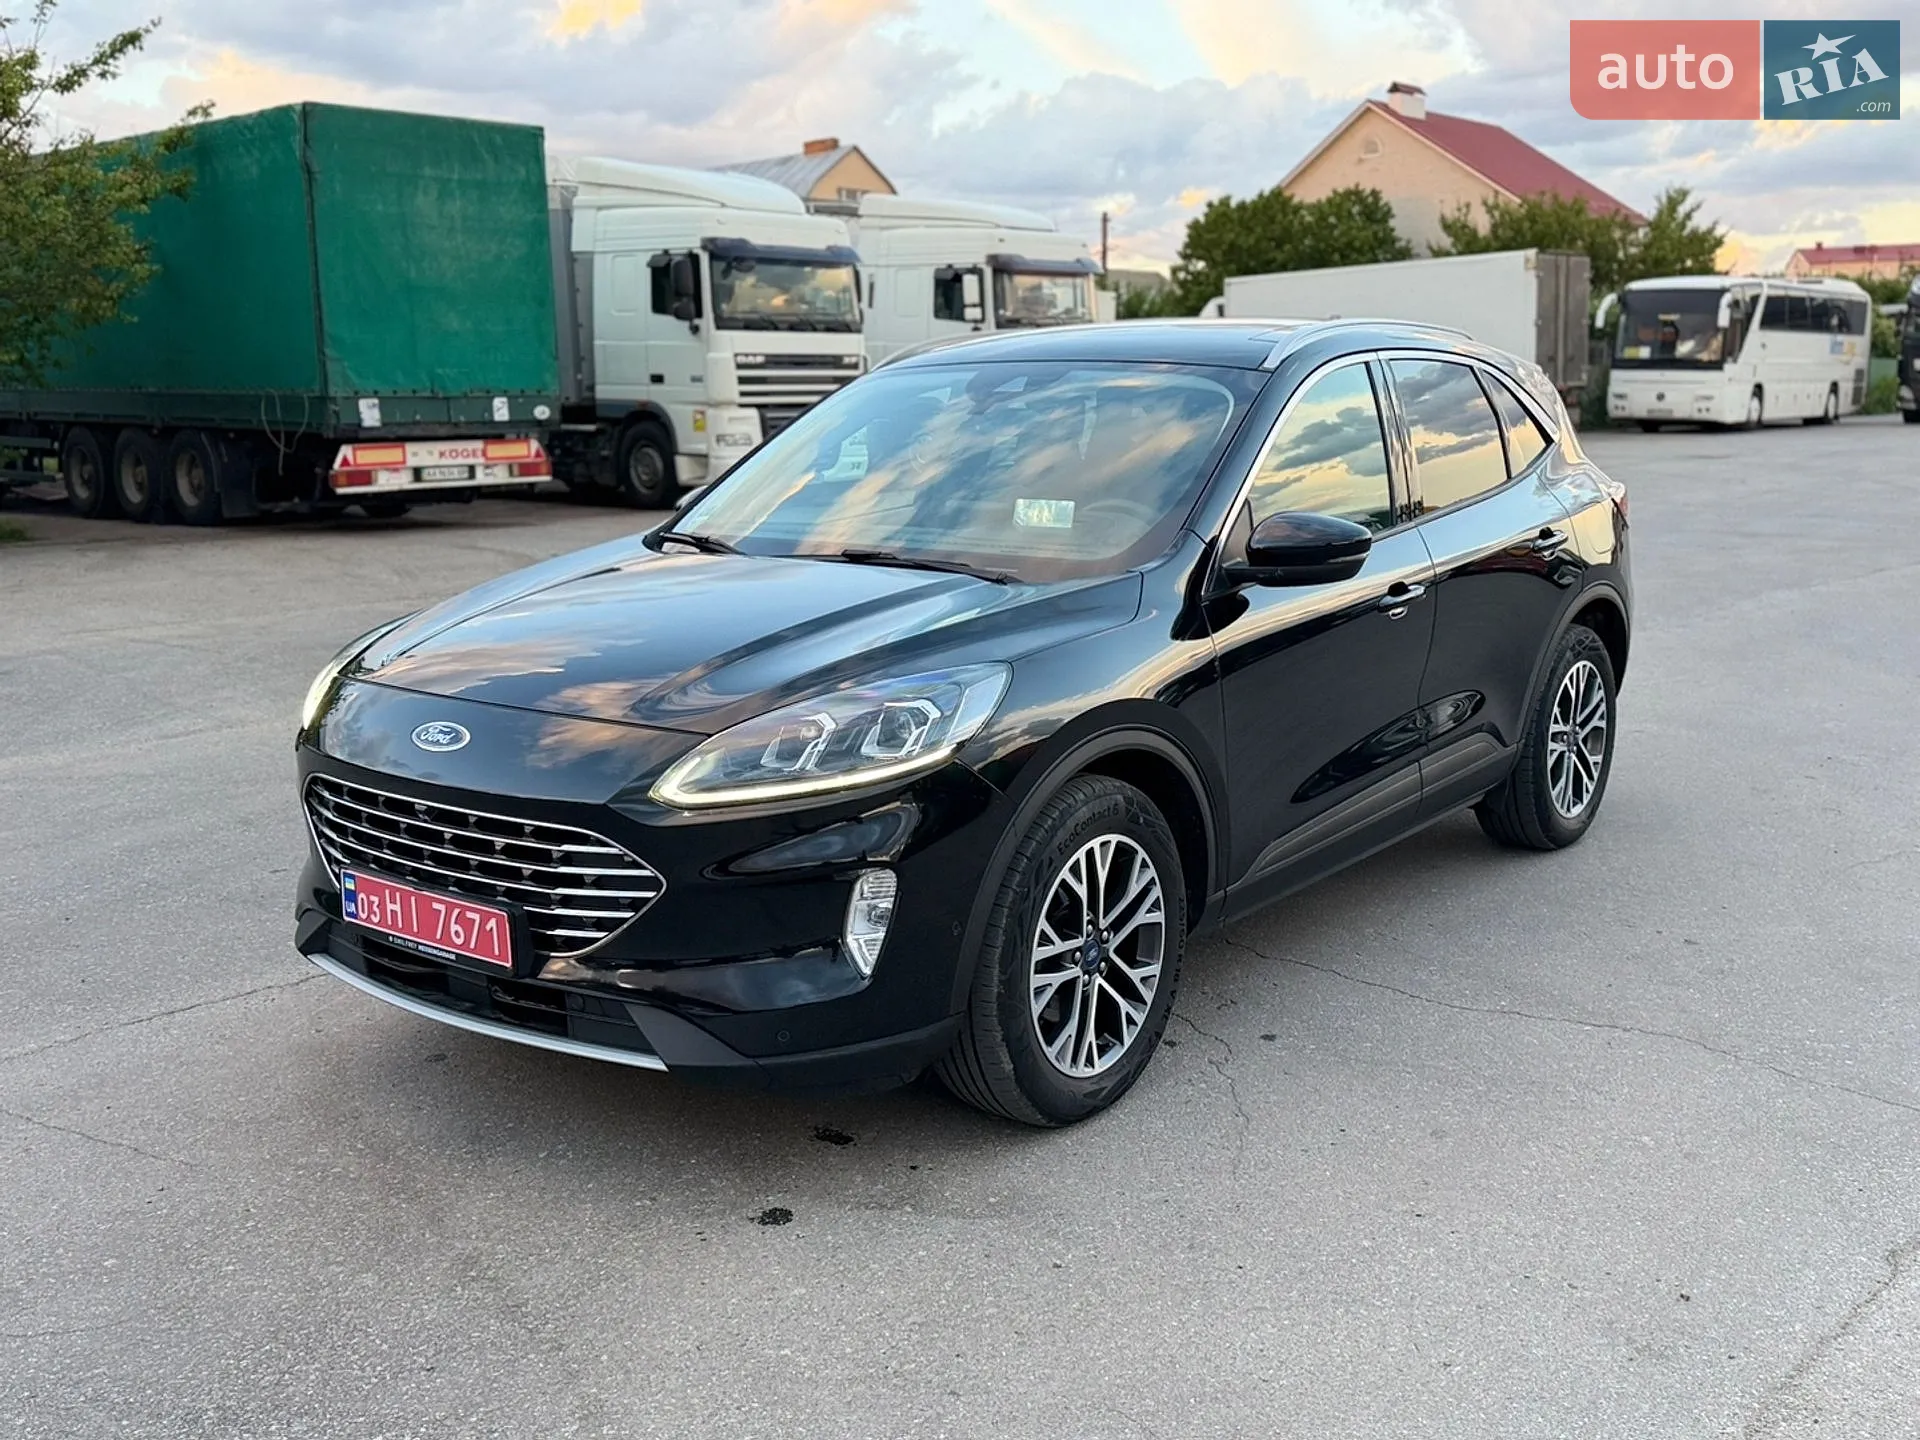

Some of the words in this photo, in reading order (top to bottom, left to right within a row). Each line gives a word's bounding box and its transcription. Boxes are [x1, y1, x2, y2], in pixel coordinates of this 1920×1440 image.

[420, 725, 456, 744] Ford
[346, 900, 356, 914] UA
[431, 902, 499, 956] 7671
